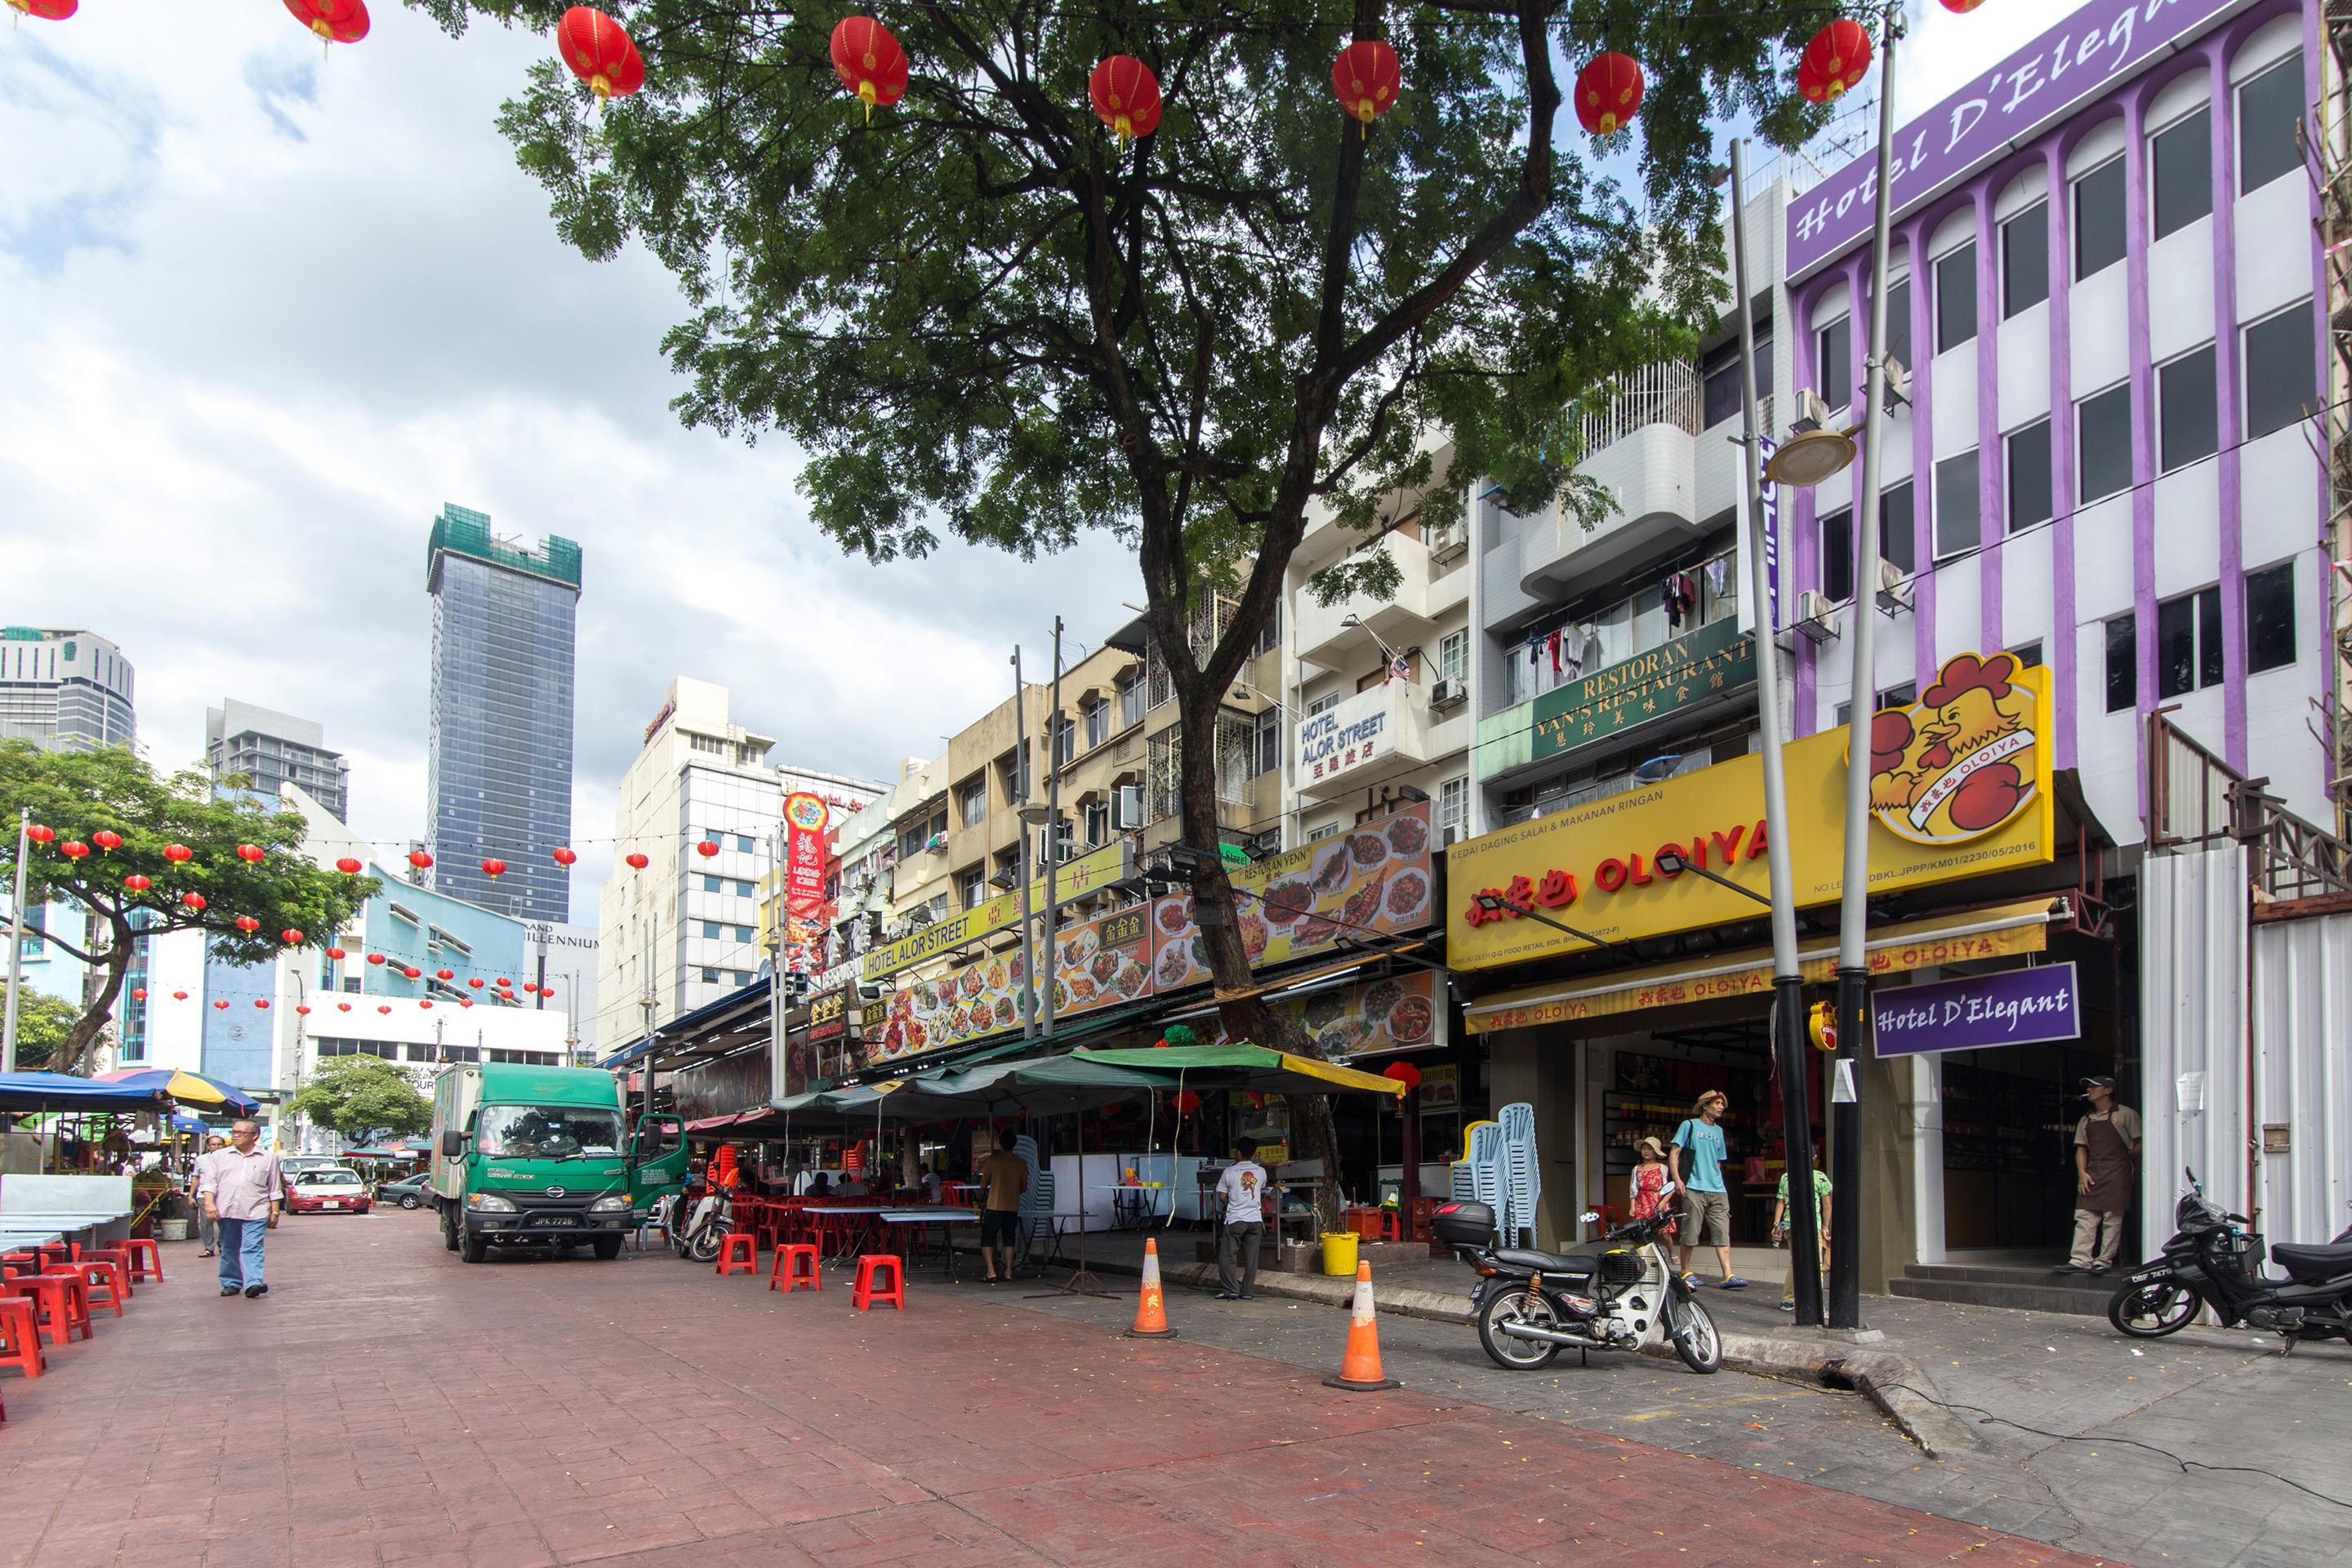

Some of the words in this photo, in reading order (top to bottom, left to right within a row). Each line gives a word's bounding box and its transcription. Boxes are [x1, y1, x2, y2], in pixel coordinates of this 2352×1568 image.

[1795, 129, 1930, 242] Hotel
[1583, 639, 1690, 701] RESTORAN
[1535, 702, 1592, 738] YAN'S
[1597, 638, 1753, 715] RESTAURANT
[1301, 711, 1339, 745] HOTEL
[1302, 737, 1334, 766] ALOR
[1337, 711, 1386, 750] STREET
[1960, 737, 2020, 774] OLOIYA
[1451, 845, 1478, 861] KEDAI
[1481, 833, 1517, 853] DAGING
[1519, 824, 1548, 840] SALAI
[1550, 822, 1557, 831] &
[1560, 804, 1615, 829] MAKANAN
[1618, 791, 1664, 812] RINGAN
[1244, 859, 1282, 880] RESTORAN
[1283, 850, 1307, 870] YENN
[1594, 819, 1768, 893] OLOIYA
[1813, 880, 1842, 893] NO.LE
[524, 932, 599, 949] ILLENNIU
[867, 949, 898, 975] HOTEL
[898, 939, 925, 960] ALOR
[927, 916, 969, 950] STREET
[1503, 946, 1521, 956] FOOD
[1522, 941, 1546, 952] RETAIL
[1546, 938, 1561, 947] SDN.
[1902, 938, 1993, 965] OLOIYA
[1694, 974, 1763, 997] OLOIYA
[1535, 1003, 1588, 1022] OLOIYA
[1878, 1003, 1937, 1033] Hotel
[1942, 987, 2069, 1032] D'Elegant
[535, 1217, 551, 1226] JPK
[552, 1217, 572, 1225] 7726
